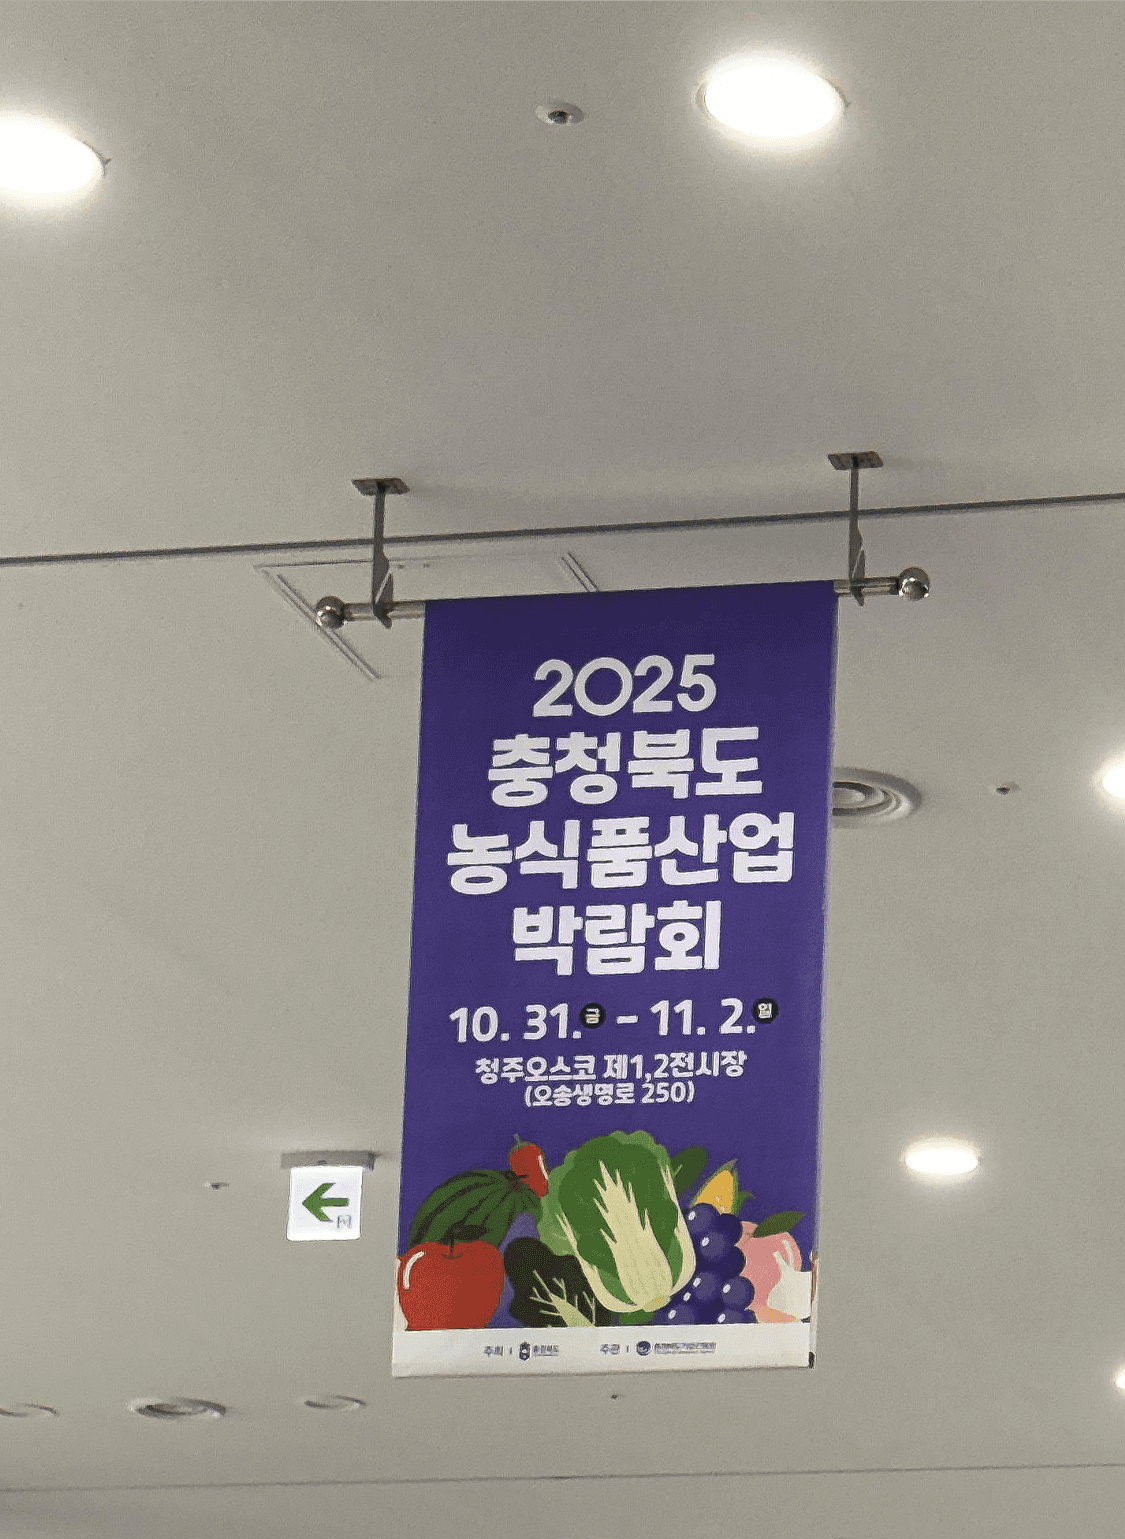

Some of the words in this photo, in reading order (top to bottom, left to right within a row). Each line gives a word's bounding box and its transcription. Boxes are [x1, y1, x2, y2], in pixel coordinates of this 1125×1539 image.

[532, 653, 717, 718] 2025
[488, 726, 763, 808] 충청북도
[447, 811, 795, 895] 농식품산업
[512, 899, 722, 976] 박람회
[475, 1053, 597, 1086] 청주오스코
[603, 1050, 748, 1083] 제1,2전시장
[641, 1079, 695, 1105] 250)
